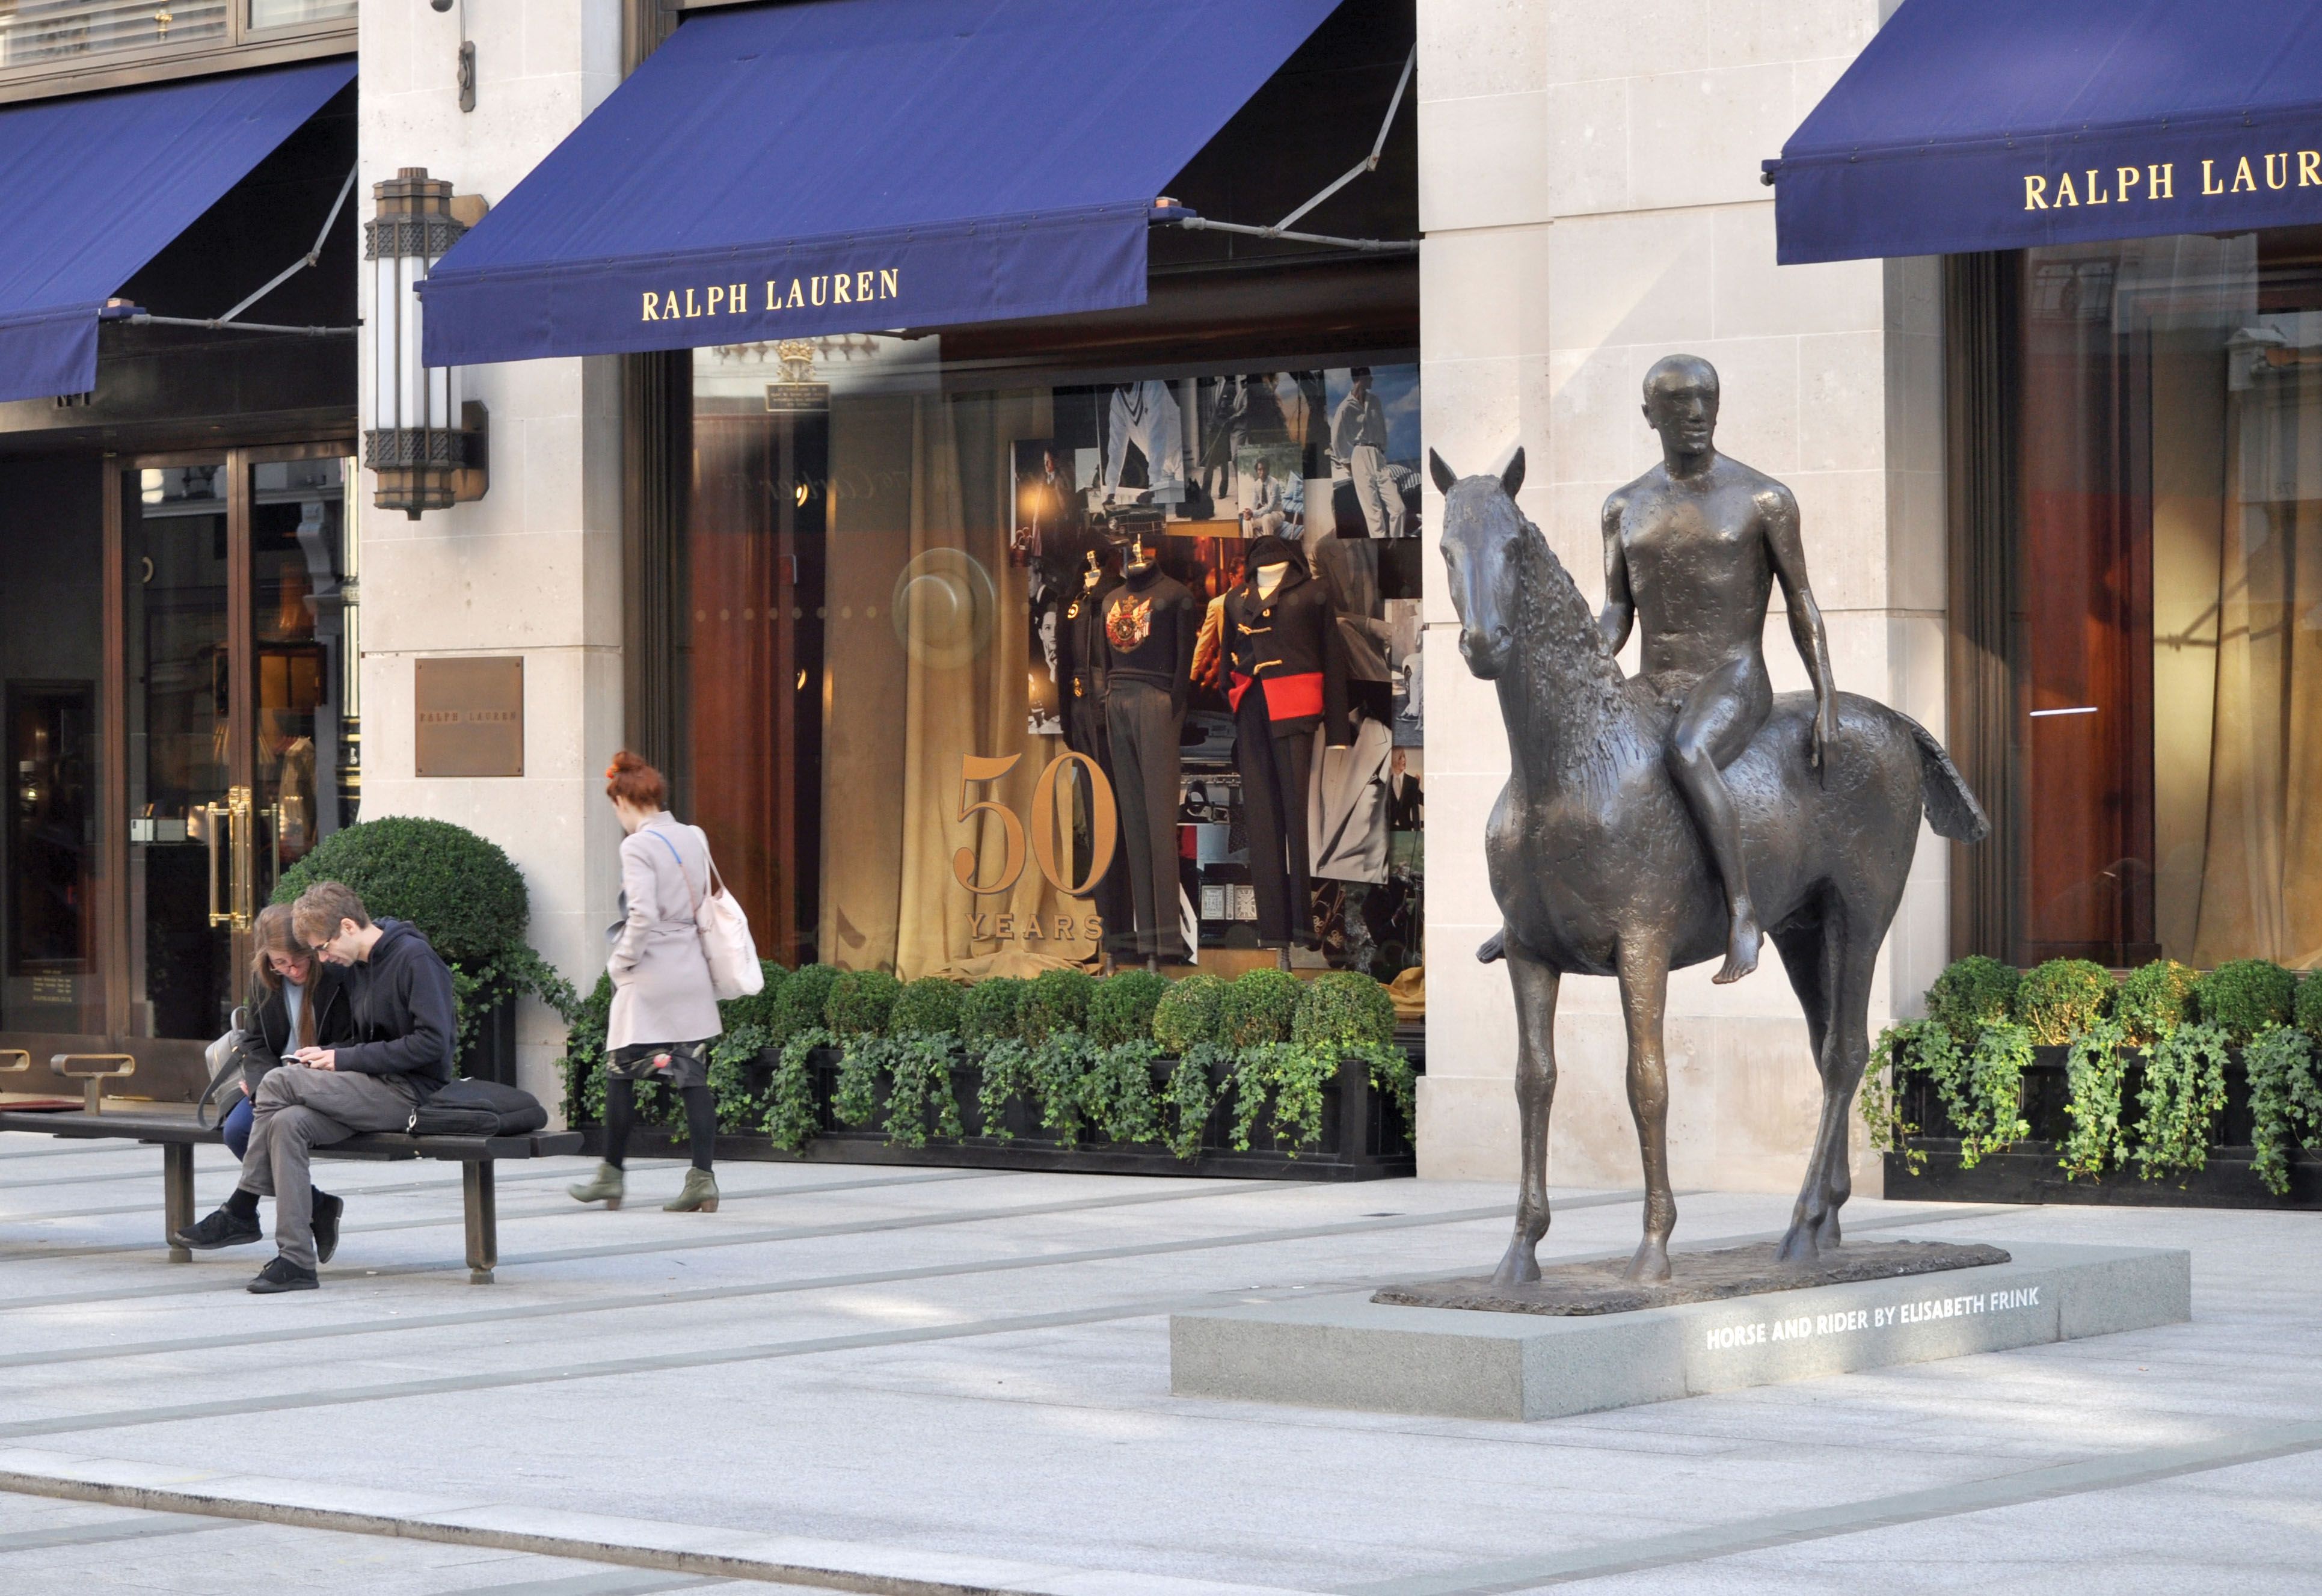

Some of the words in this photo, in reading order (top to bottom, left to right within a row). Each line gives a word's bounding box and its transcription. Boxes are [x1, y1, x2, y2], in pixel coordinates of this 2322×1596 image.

[2024, 163, 2173, 210] RALPH
[642, 283, 748, 321] RALPH
[766, 269, 898, 310] LAUREN
[420, 711, 458, 722] RALPH
[469, 711, 516, 722] LAUREN
[953, 752, 1117, 895] 50
[965, 913, 1104, 941] YEARS
[1707, 1323, 1766, 1350] HORSE
[1772, 1317, 1812, 1341] AND
[1817, 1310, 1869, 1335] RIDER
[1875, 1306, 1896, 1327] BY
[1900, 1294, 1985, 1324] ELISABETH
[1991, 1286, 2039, 1311] FRINK
